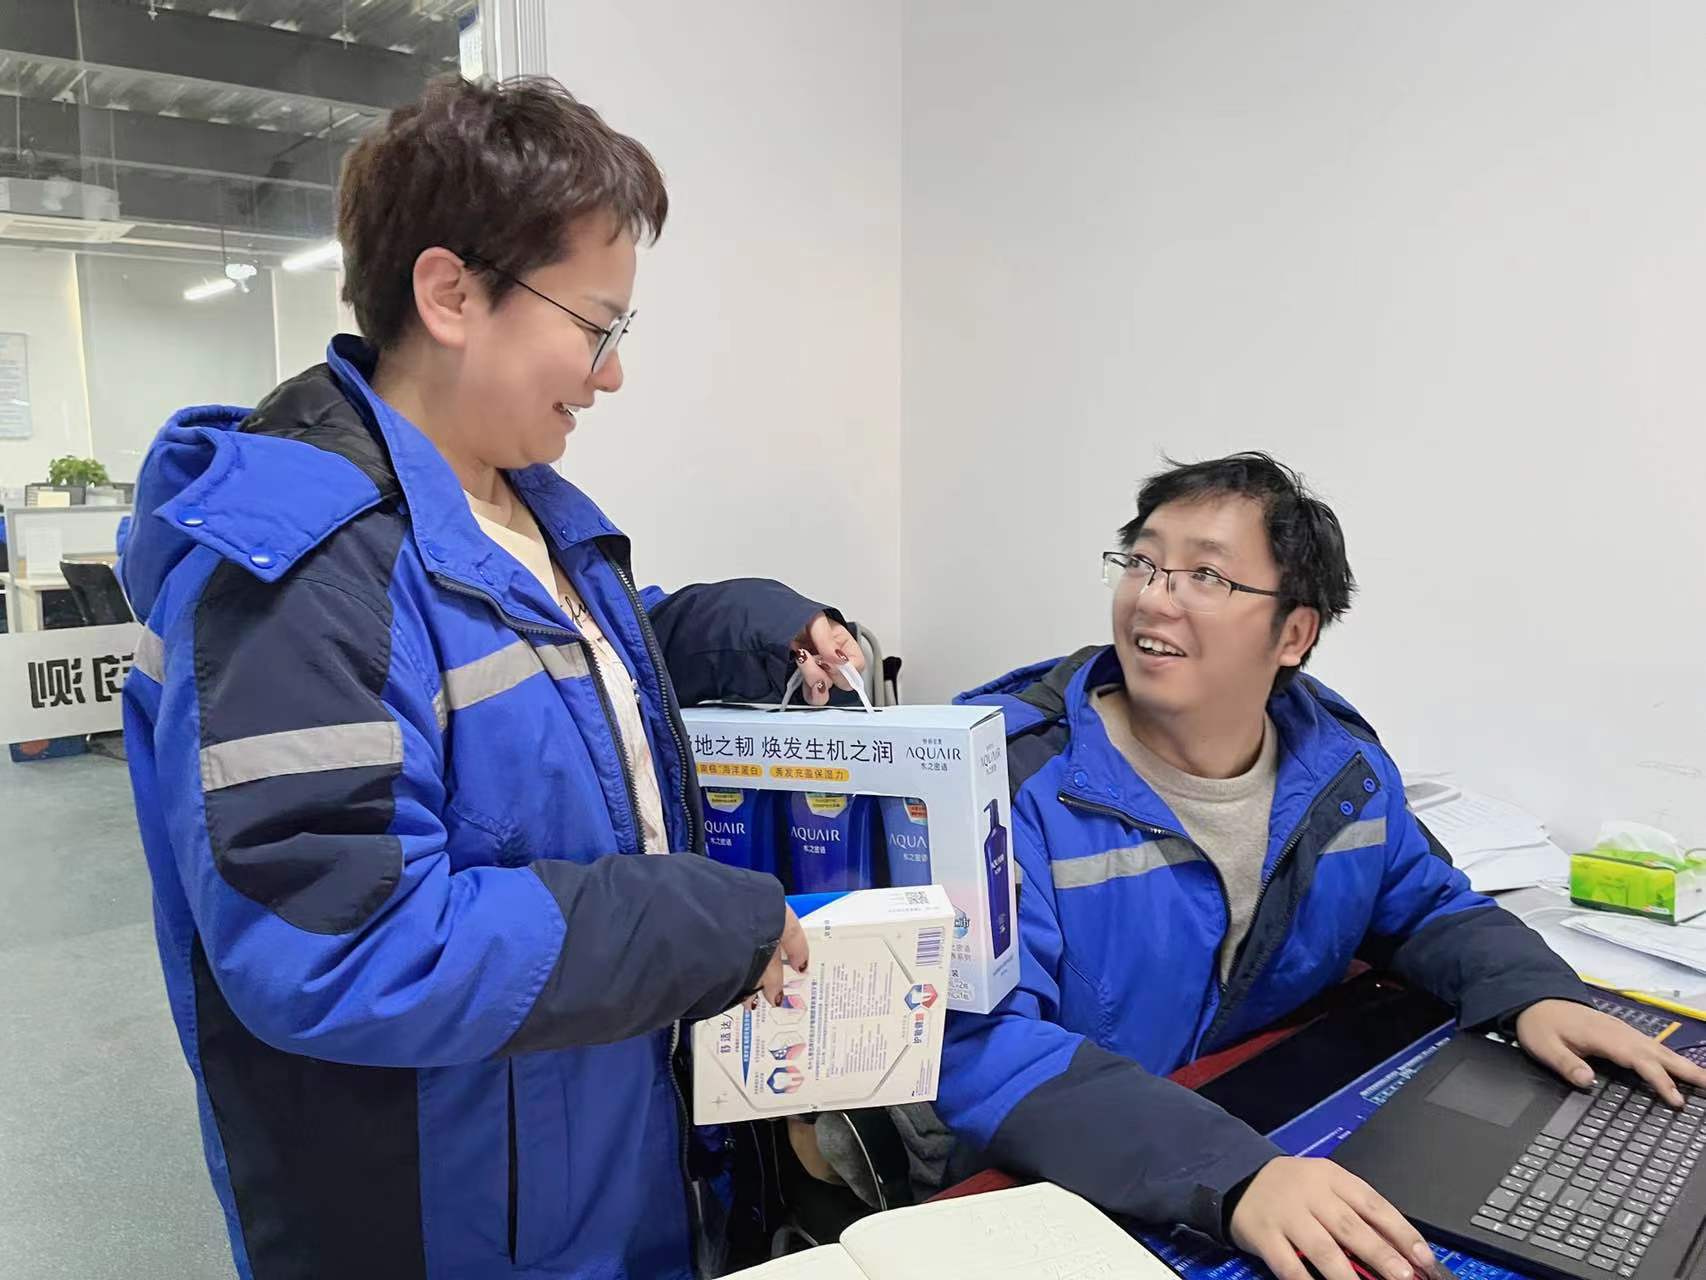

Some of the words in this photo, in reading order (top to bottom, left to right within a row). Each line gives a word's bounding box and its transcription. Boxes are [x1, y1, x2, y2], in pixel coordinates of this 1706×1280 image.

[688, 734, 753, 757] 地之韧
[762, 736, 893, 763] 焕发生机之润
[906, 746, 961, 760] AQUAIR
[704, 820, 745, 834] QUAIR
[791, 826, 841, 841] AQUAIR
[888, 833, 928, 848] AQUA
